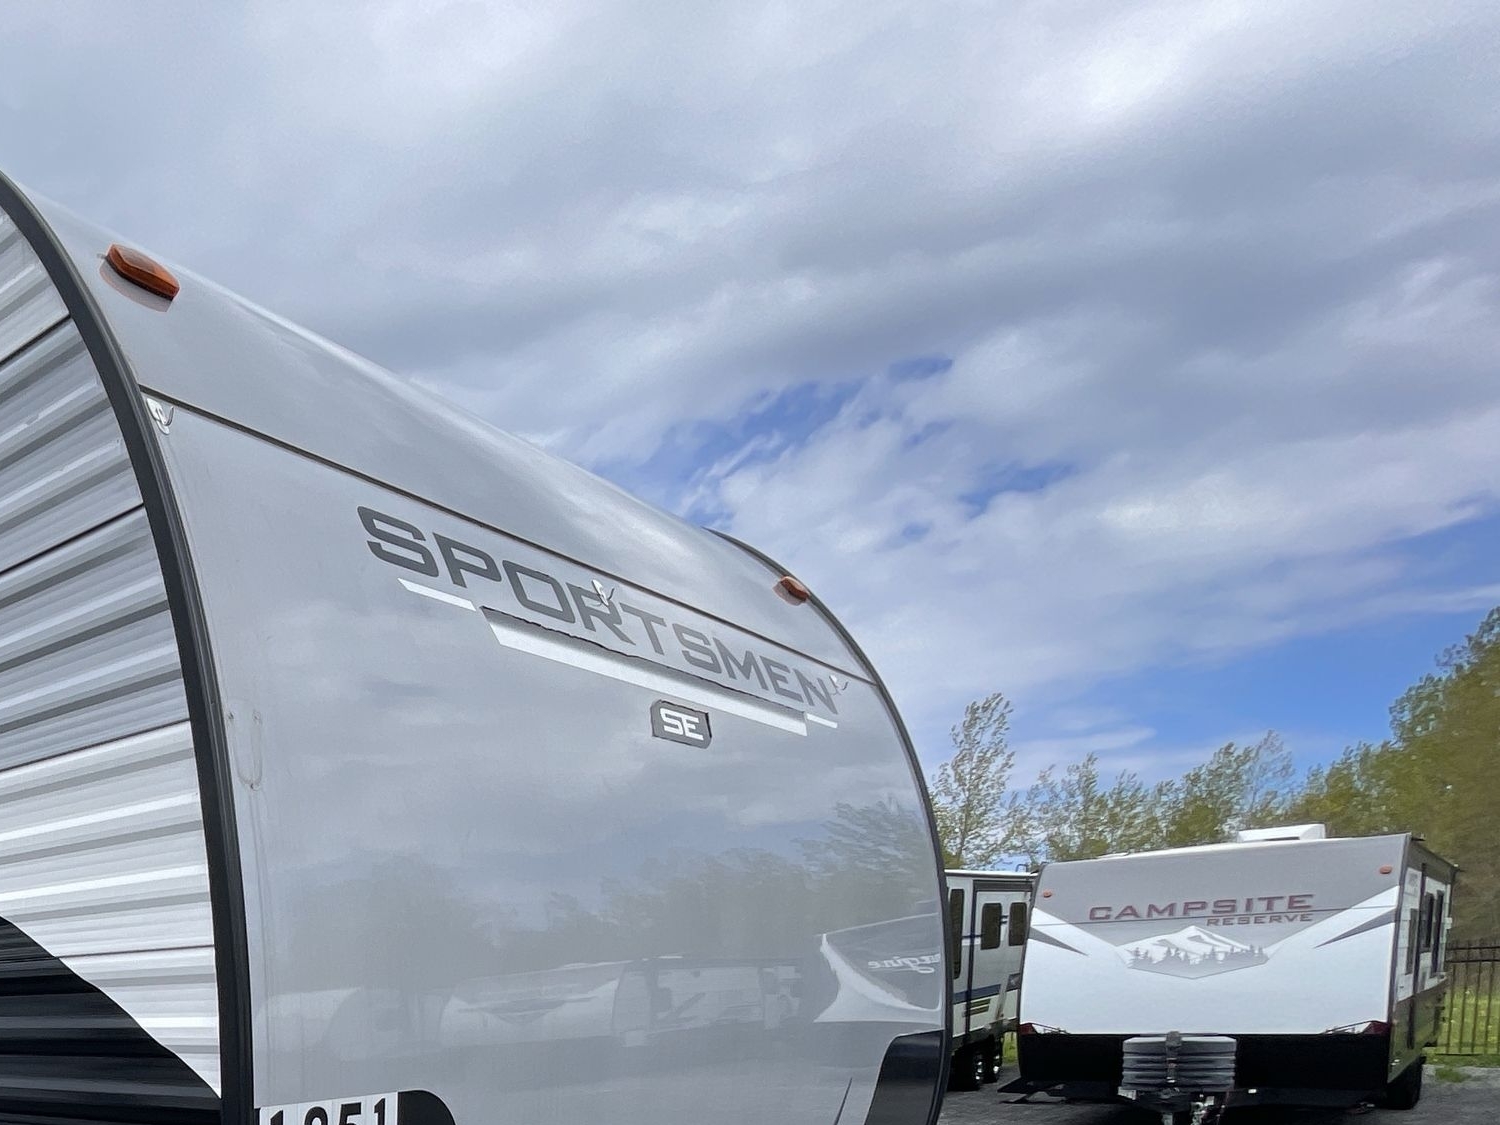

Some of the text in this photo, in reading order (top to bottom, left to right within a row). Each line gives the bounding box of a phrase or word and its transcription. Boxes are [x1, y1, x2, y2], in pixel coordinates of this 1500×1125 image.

[356, 505, 839, 715] SPORTSMEN
[659, 707, 705, 741] SE
[1089, 893, 1316, 921] CAMPSITE
[1206, 913, 1314, 928] RESERVE
